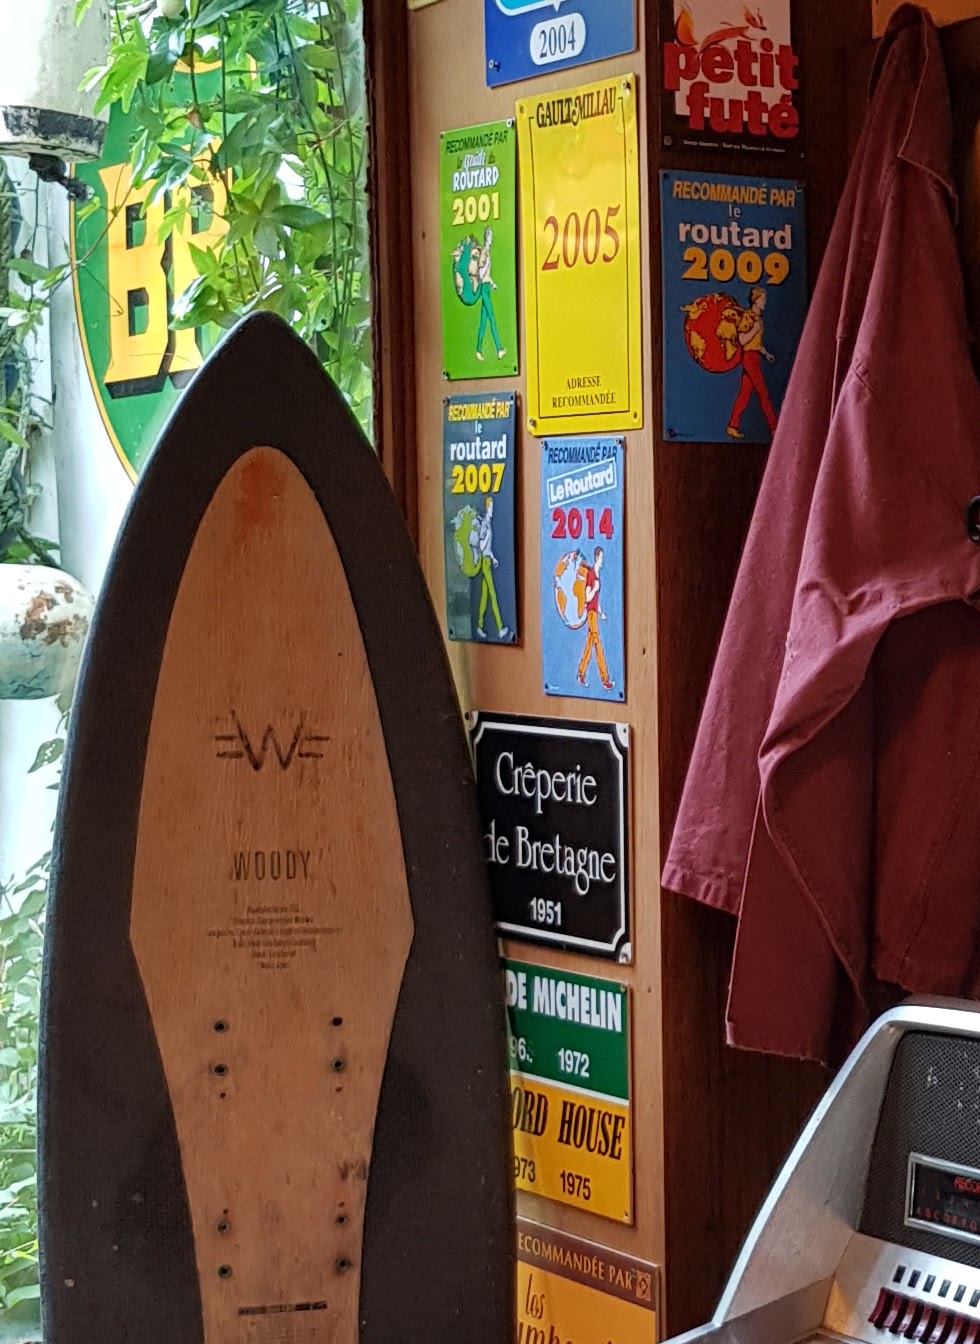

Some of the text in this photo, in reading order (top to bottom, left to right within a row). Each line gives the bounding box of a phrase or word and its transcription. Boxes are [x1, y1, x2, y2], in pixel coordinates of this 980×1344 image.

[538, 21, 577, 58] 2004
[663, 37, 799, 92] petit
[686, 81, 800, 139] futé
[494, 130, 508, 145] PAR
[453, 166, 499, 192] ROUTARD
[673, 180, 796, 208] RECOMMANDÉ PAR
[452, 191, 499, 226] 2001
[729, 203, 741, 217] le
[542, 204, 620, 271] 2005
[679, 221, 792, 250] routard
[98, 138, 234, 396] BP
[682, 246, 790, 285] 2009
[566, 376, 601, 389] ADRESSE
[448, 398, 510, 421] RECOMMANDÉ PAR
[552, 390, 616, 408] RECOMMANDÉE
[475, 420, 482, 433] le
[450, 434, 507, 461] routard
[548, 442, 618, 464] RECOMMANDÉ PAR
[452, 463, 505, 493] 2007
[552, 508, 614, 539] 2014
[496, 752, 597, 814] Crêperie
[233, 851, 311, 881] WOODY
[516, 825, 616, 895] Bretagne
[530, 897, 562, 925] 1951
[533, 976, 622, 1032] MICHELIN
[510, 1036, 590, 1077] 96 1972
[558, 1100, 625, 1160] HOUSE
[560, 1170, 591, 1200] 1975
[526, 1274, 545, 1319] les
